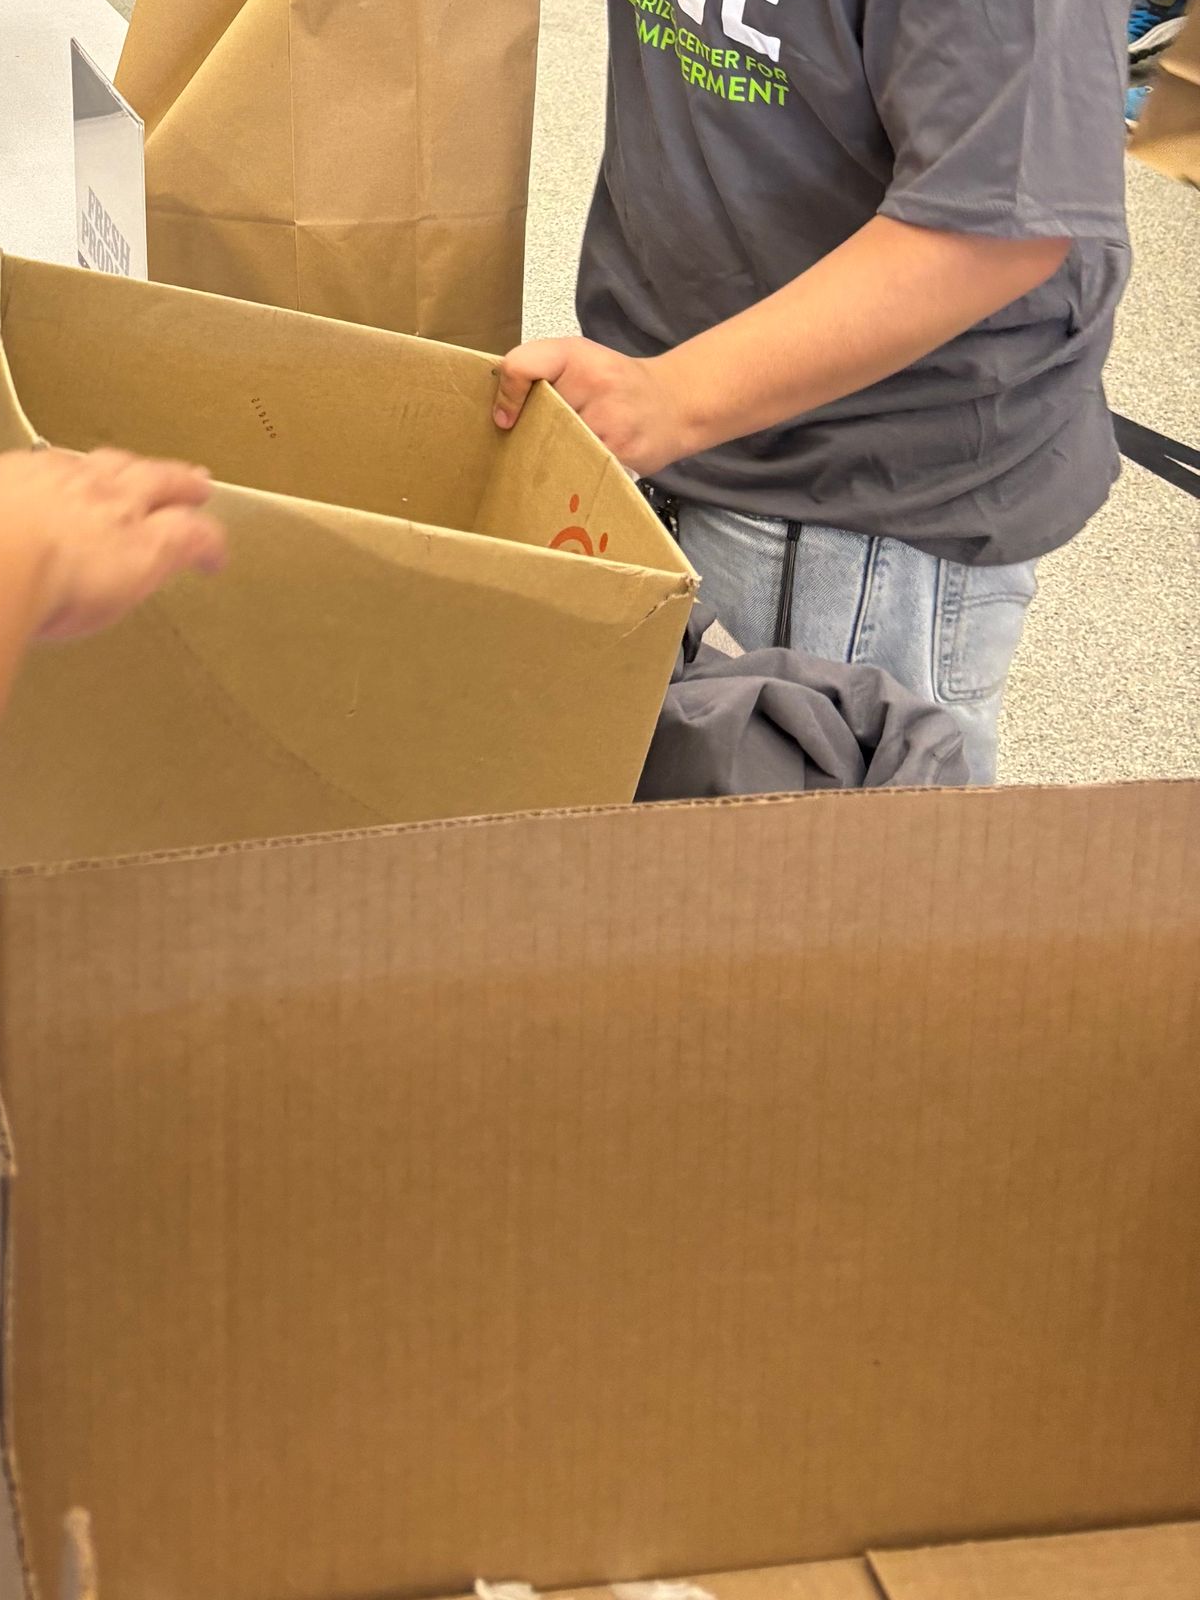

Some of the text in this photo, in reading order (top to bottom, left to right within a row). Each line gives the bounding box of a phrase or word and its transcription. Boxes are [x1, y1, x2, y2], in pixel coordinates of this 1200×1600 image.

[677, 27, 741, 70] CENTER
[745, 55, 789, 84] FOR
[81, 208, 120, 275] PROD
[87, 185, 131, 277] FRESH
